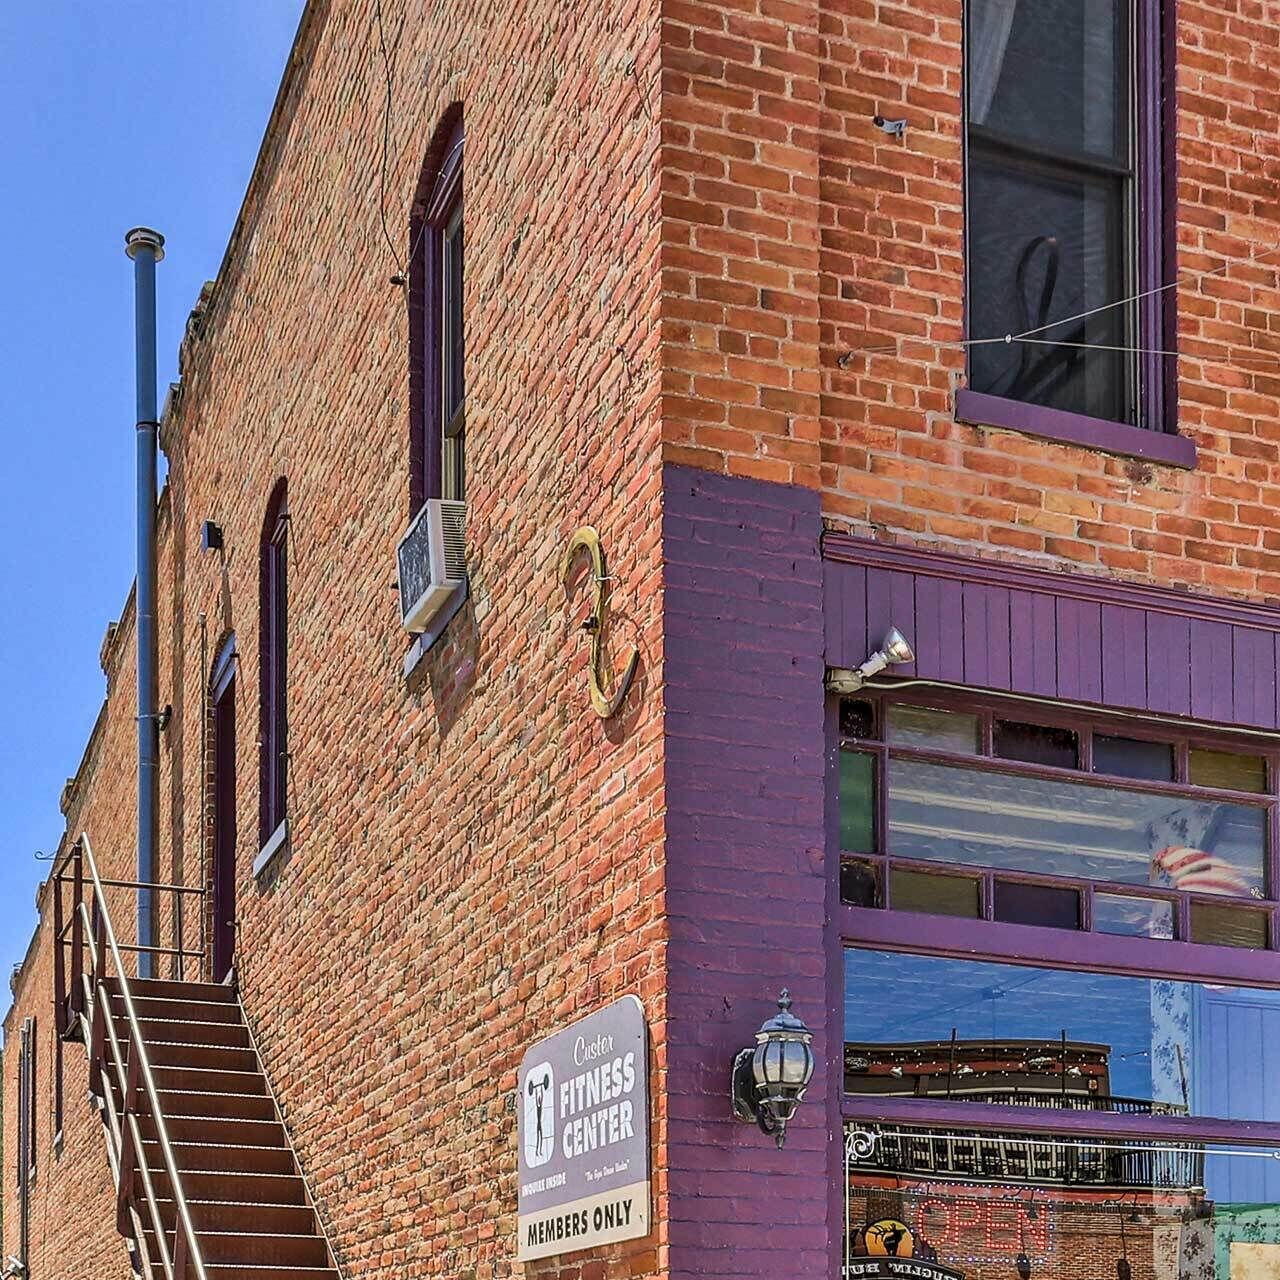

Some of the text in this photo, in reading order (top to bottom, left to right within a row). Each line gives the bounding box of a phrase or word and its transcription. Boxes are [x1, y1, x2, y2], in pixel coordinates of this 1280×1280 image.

[574, 1034, 614, 1066] Custer
[560, 1052, 635, 1119] FITNESS
[563, 1100, 634, 1159] CENTER
[546, 1171, 567, 1190] INSIDE
[527, 1199, 632, 1247] MEMBERS ONLY
[918, 1199, 1047, 1250] OPEN
